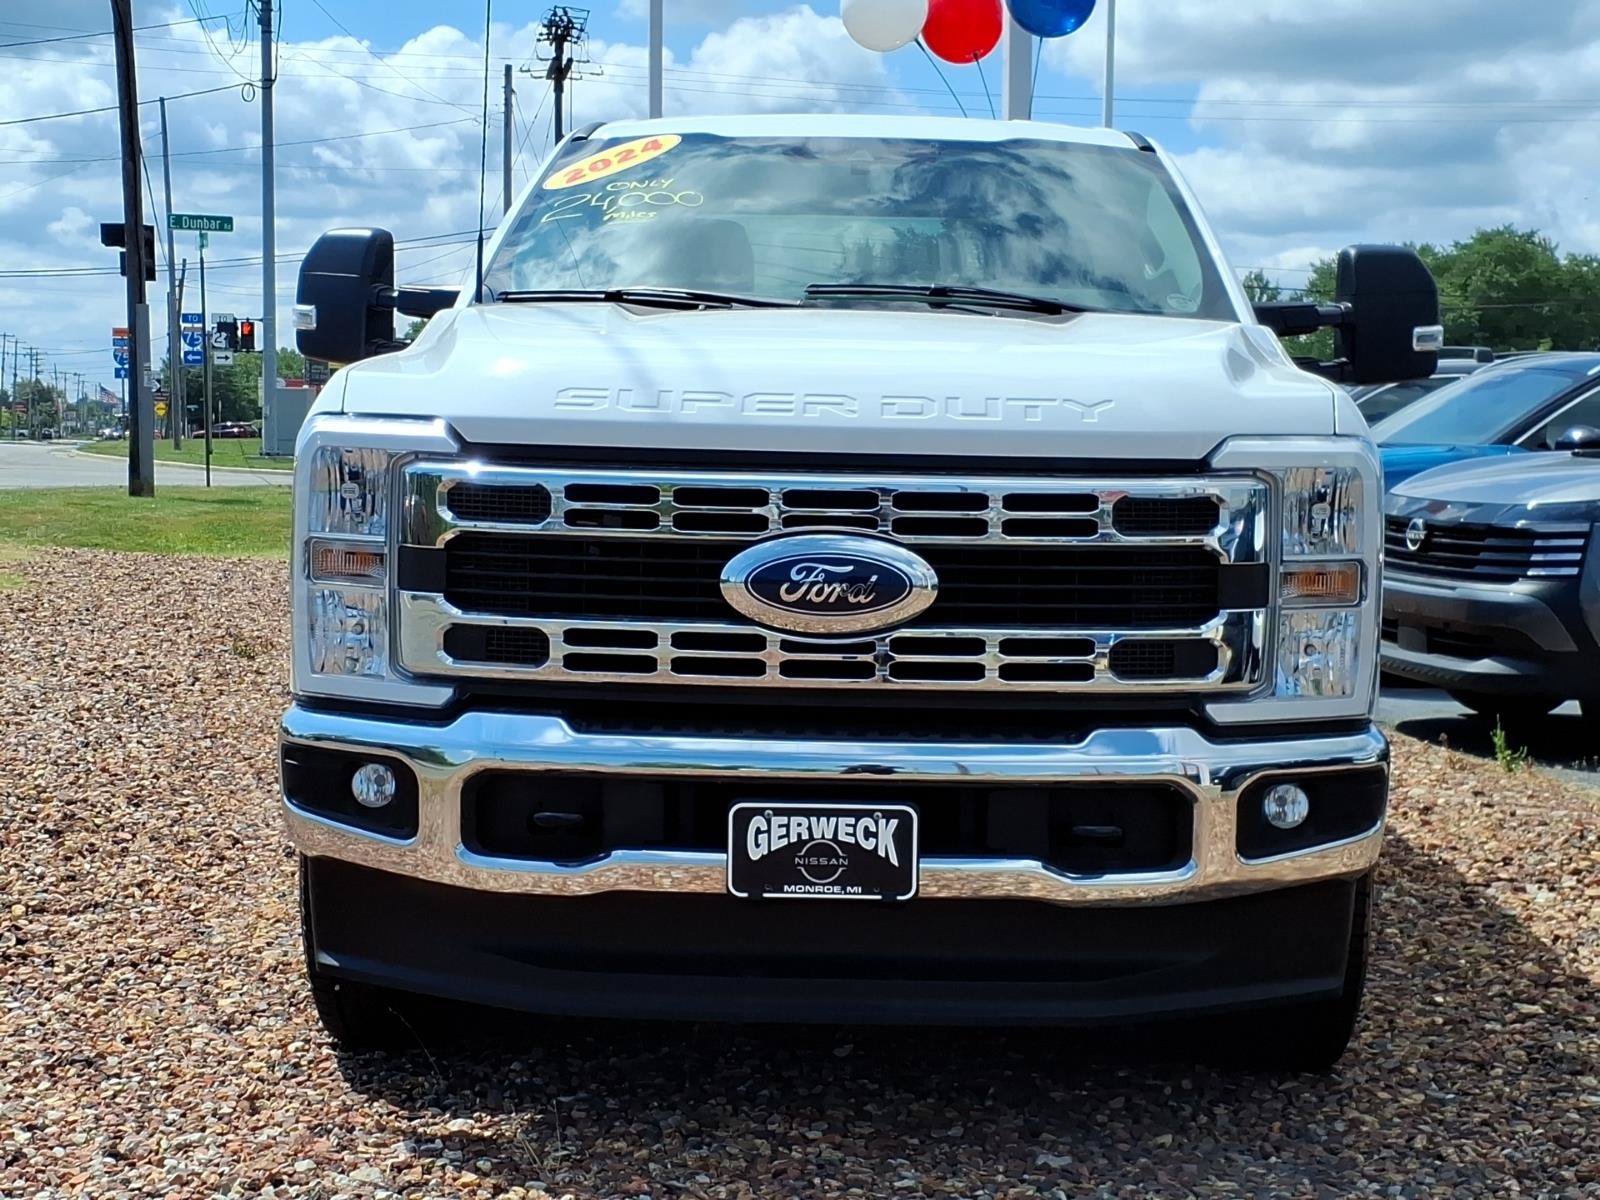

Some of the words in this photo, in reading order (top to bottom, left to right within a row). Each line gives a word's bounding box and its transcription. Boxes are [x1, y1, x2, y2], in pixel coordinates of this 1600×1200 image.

[563, 138, 663, 184] 2024
[606, 178, 674, 191] ONLY
[169, 215, 180, 228] E.
[182, 216, 221, 229] Dunbar
[188, 314, 199, 322] TO
[183, 331, 202, 344] 75
[553, 387, 859, 418] SUPER
[881, 395, 1116, 422] DUTY
[779, 562, 879, 604] Ford
[746, 815, 900, 868] GERWECK
[794, 857, 849, 867] NISSAN
[783, 884, 845, 895] MONROE,
[847, 885, 863, 894] MI
